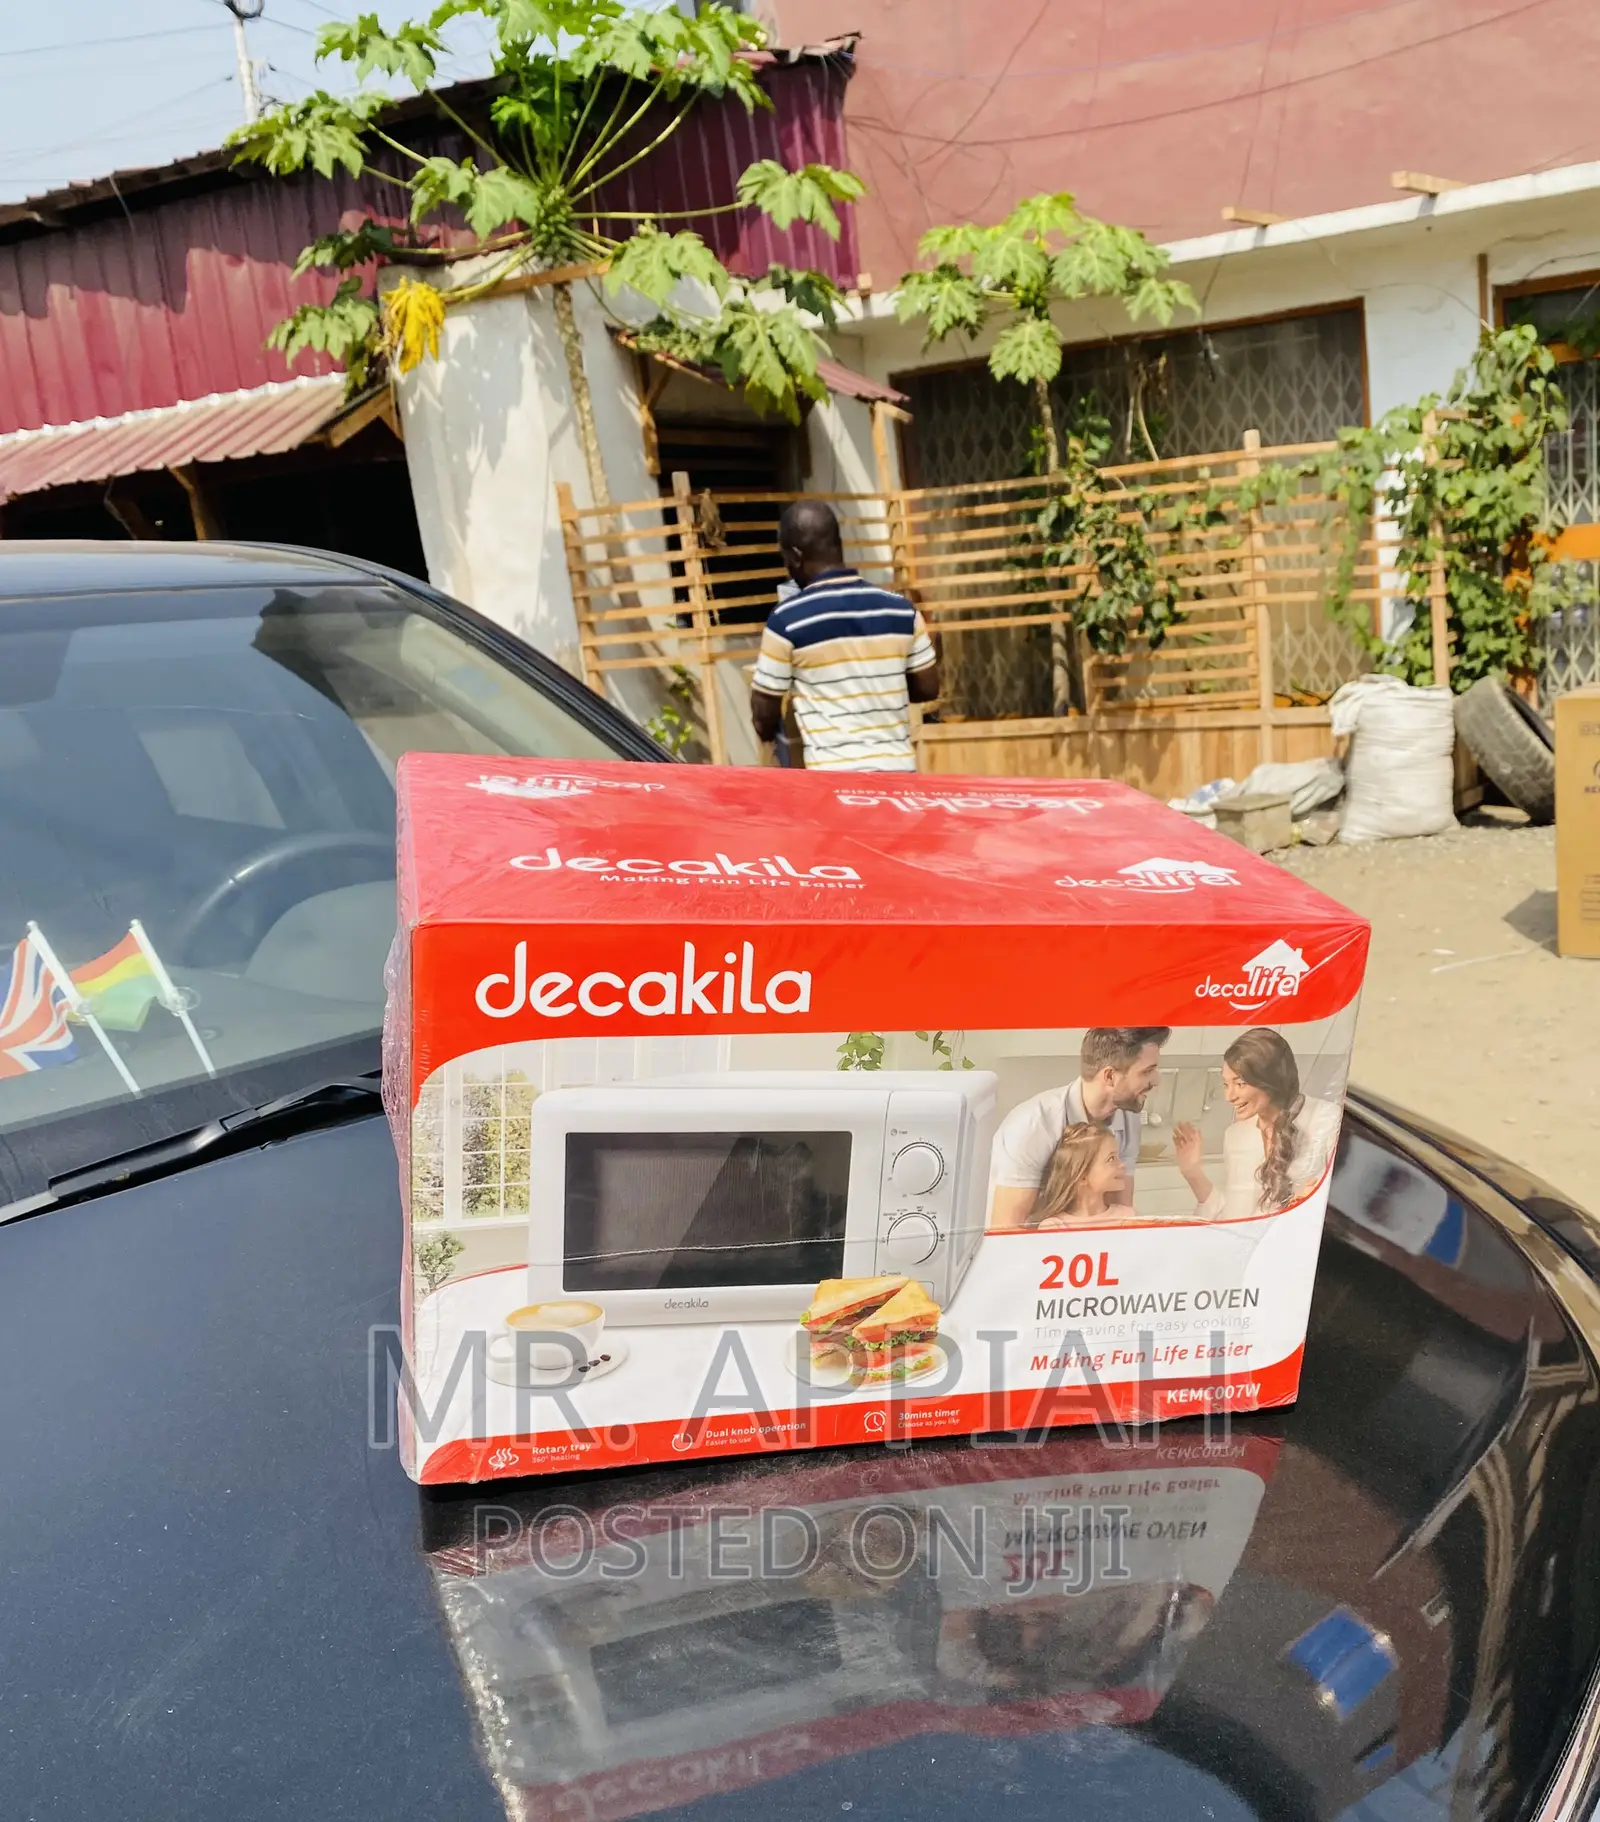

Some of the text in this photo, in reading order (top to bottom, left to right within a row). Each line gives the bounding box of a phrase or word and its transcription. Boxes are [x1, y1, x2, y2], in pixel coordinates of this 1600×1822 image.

[509, 847, 861, 880] decakila
[600, 874, 867, 889] Making Fun Life Easier
[474, 940, 812, 1019] decakila
[1039, 1252, 1119, 1289] 20L
[1035, 1287, 1260, 1320] MICROWAVE OVEN
[1156, 1320, 1188, 1333] easy
[1030, 1342, 1253, 1372] Making Fun Life Easier
[1167, 1382, 1262, 1405] KEMC007W
[899, 1408, 960, 1421] 30mins timer
[705, 1423, 806, 1439] Dual knob operation
[898, 1420, 924, 1429] Choose
[925, 1419, 933, 1427] as
[934, 1418, 946, 1426] you
[531, 1442, 592, 1455] Rotary tray
[705, 1439, 727, 1447] Easier
[729, 1437, 737, 1445] to
[550, 1453, 581, 1462] heating
